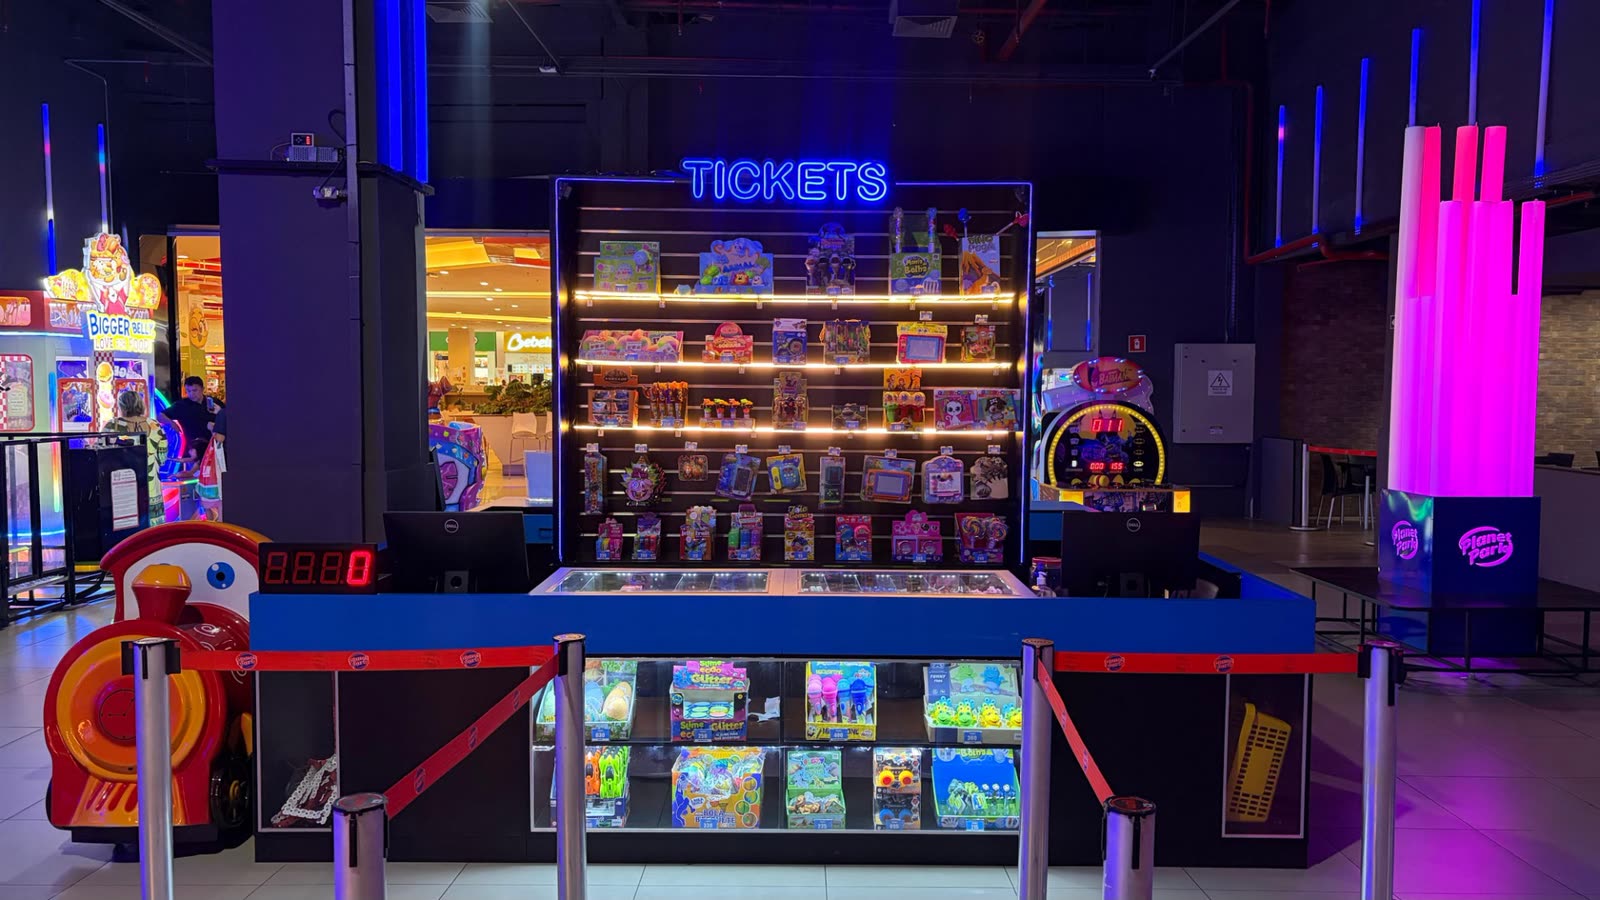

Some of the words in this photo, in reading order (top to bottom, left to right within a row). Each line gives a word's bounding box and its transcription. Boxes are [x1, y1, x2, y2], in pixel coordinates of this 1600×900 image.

[682, 159, 888, 201] TICKETS
[90, 314, 129, 336] BIGGER
[132, 322, 154, 335] BELLY
[94, 337, 114, 350] LOVE
[1393, 529, 1418, 546] Planet
[1460, 531, 1513, 556] Planet
[1396, 538, 1417, 557] Park
[1467, 541, 1509, 566] Park
[691, 673, 733, 684] Glitter
[680, 721, 704, 730] Slime
[711, 721, 744, 732] Glitter
